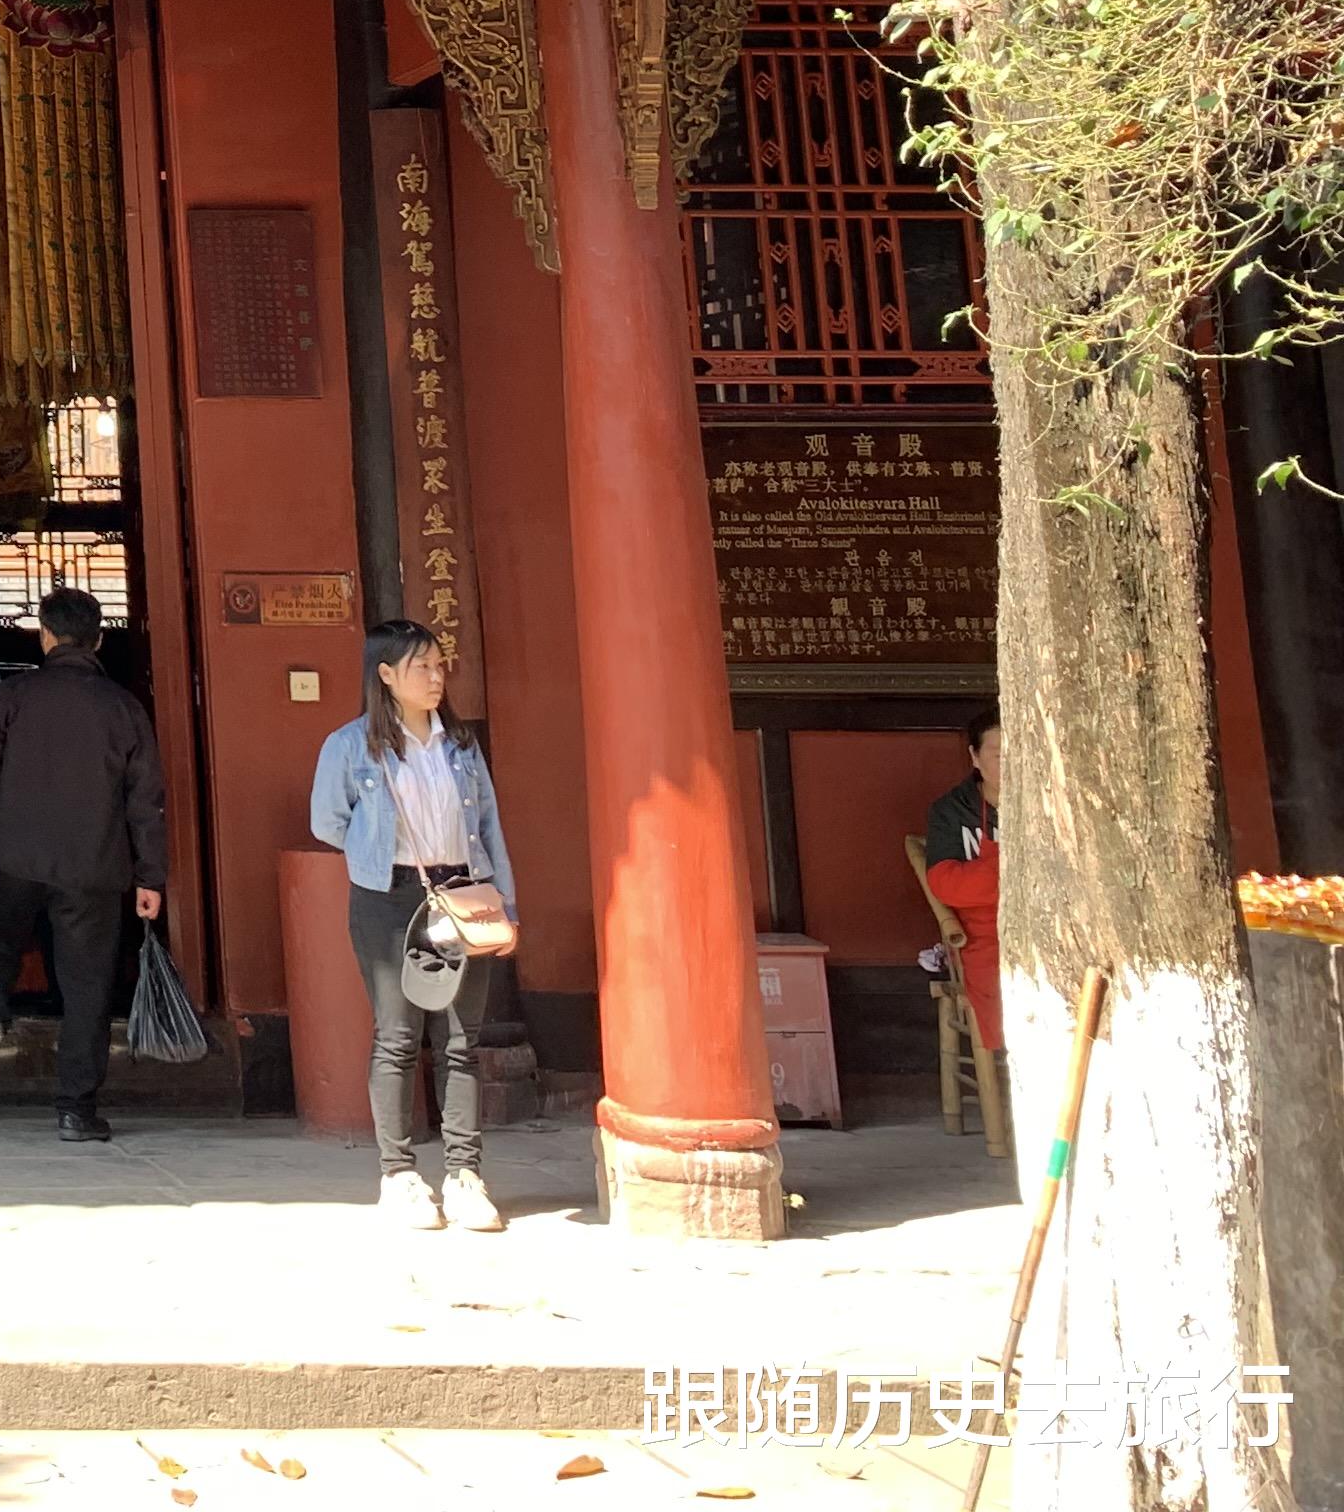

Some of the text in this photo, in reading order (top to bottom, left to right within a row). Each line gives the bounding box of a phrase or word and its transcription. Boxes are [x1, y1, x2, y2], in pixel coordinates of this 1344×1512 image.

[805, 433, 924, 457] 观音殿
[797, 496, 941, 510] Avalokitesvara Hall
[719, 511, 729, 522] It
[730, 511, 740, 522] is
[742, 511, 762, 522] also
[764, 511, 794, 522] called
[796, 511, 812, 522] the
[814, 511, 834, 522] Old
[752, 524, 766, 536] of
[892, 524, 910, 536] and
[734, 538, 764, 549] called
[766, 538, 782, 549] the
